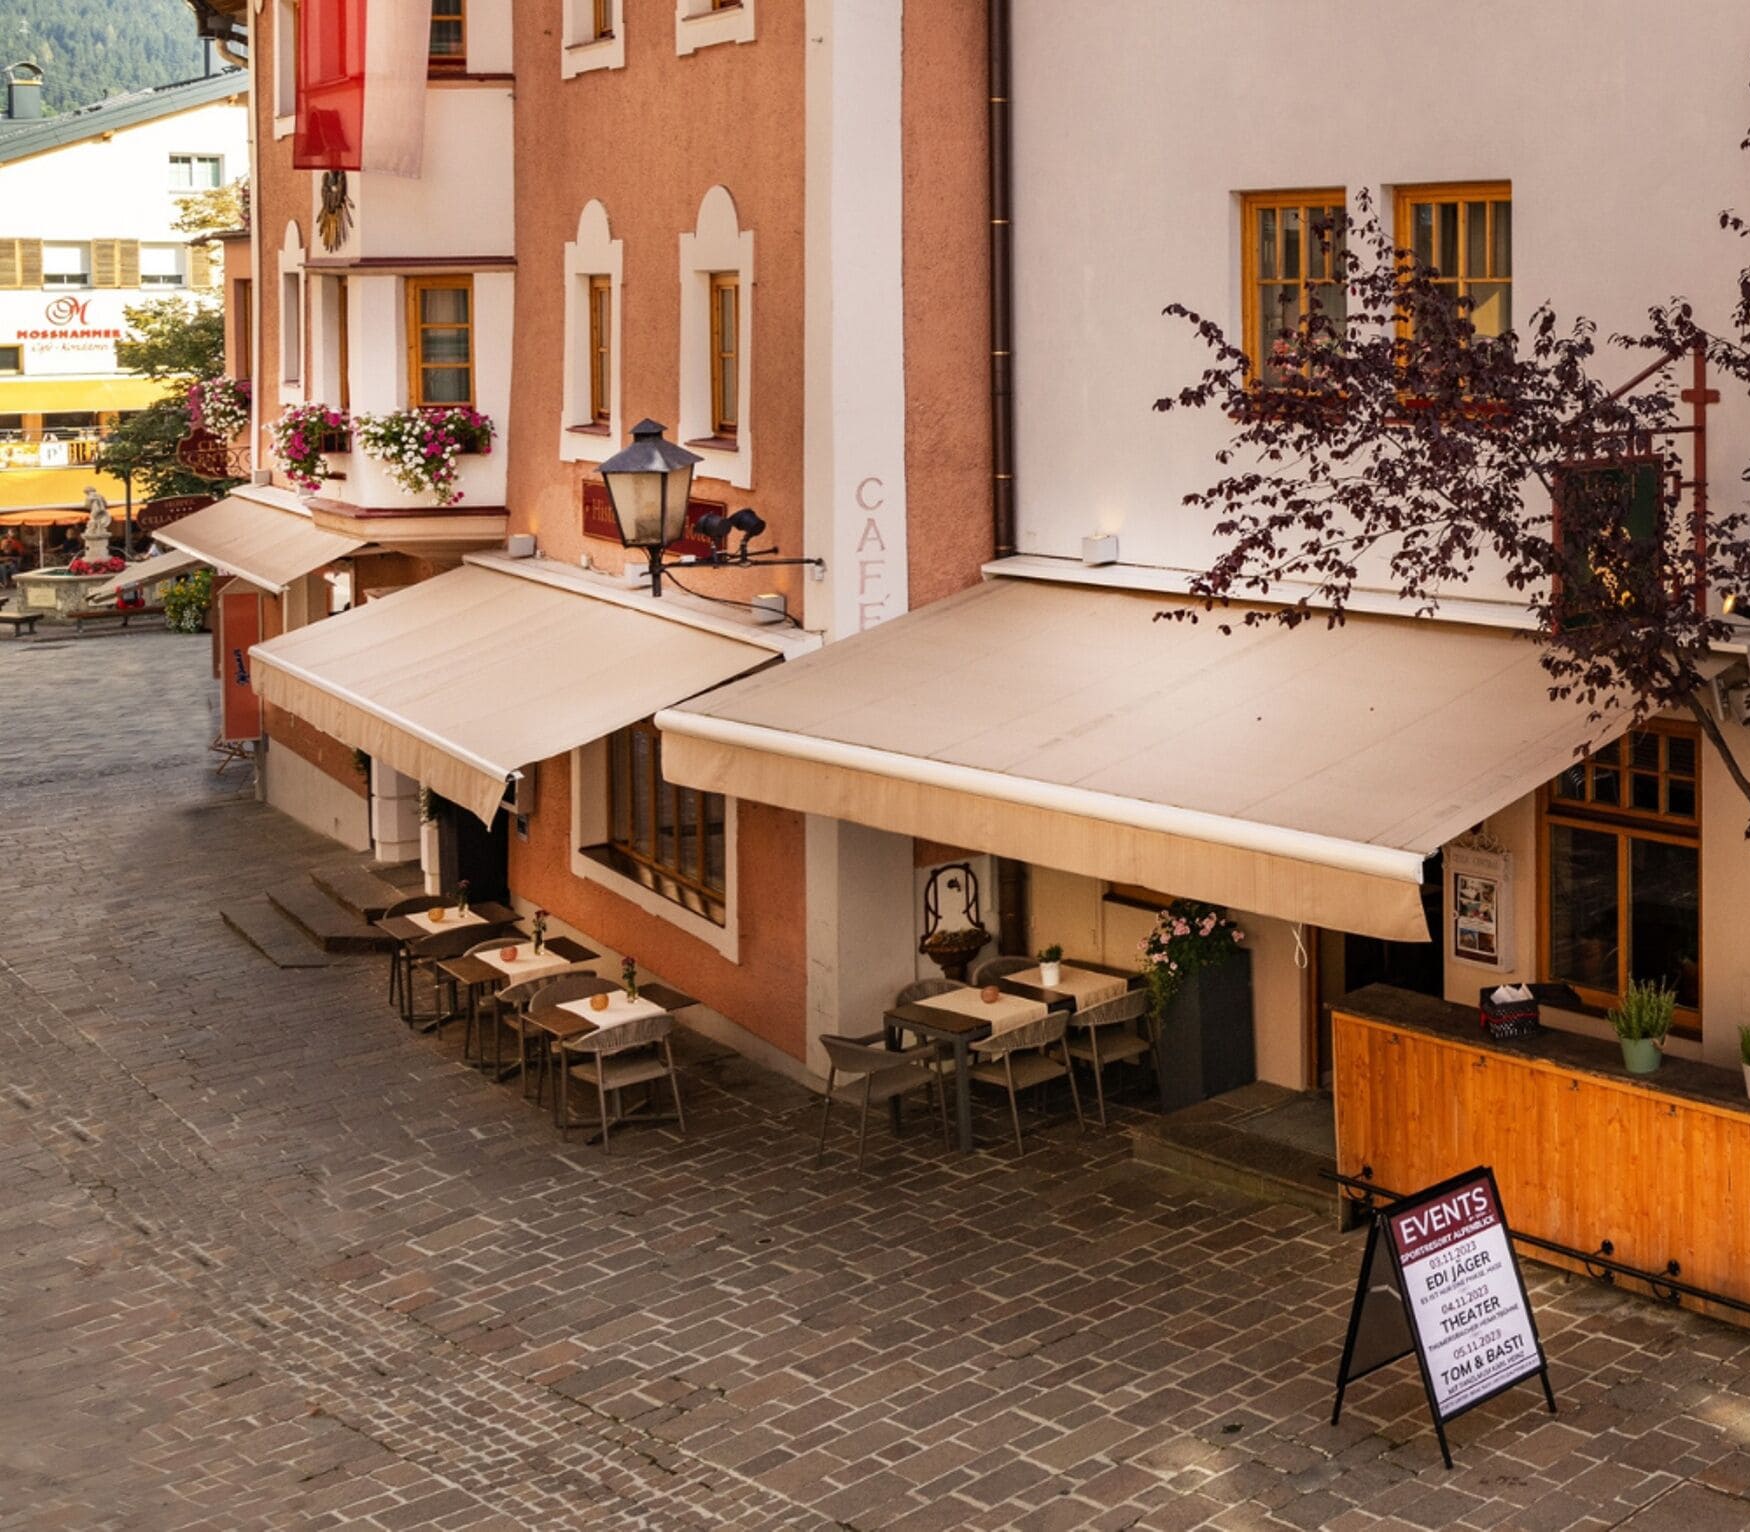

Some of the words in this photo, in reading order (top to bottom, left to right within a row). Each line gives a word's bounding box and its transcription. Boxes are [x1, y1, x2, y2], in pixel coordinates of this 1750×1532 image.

[16, 329, 121, 339] MOSSHAMMER
[1400, 1187, 1487, 1244] EVENTS
[1426, 1270, 1448, 1290] EDI
[1451, 1251, 1491, 1282] JÄGER
[1429, 1241, 1477, 1269] 03.11.2023
[1441, 1284, 1489, 1314] 04.11.2023
[1441, 1295, 1500, 1333] THEATER
[1441, 1360, 1472, 1385] TOM
[1474, 1354, 1484, 1369] &
[1486, 1333, 1524, 1363] BASTI
[1453, 1328, 1502, 1360] 05.11.2023
